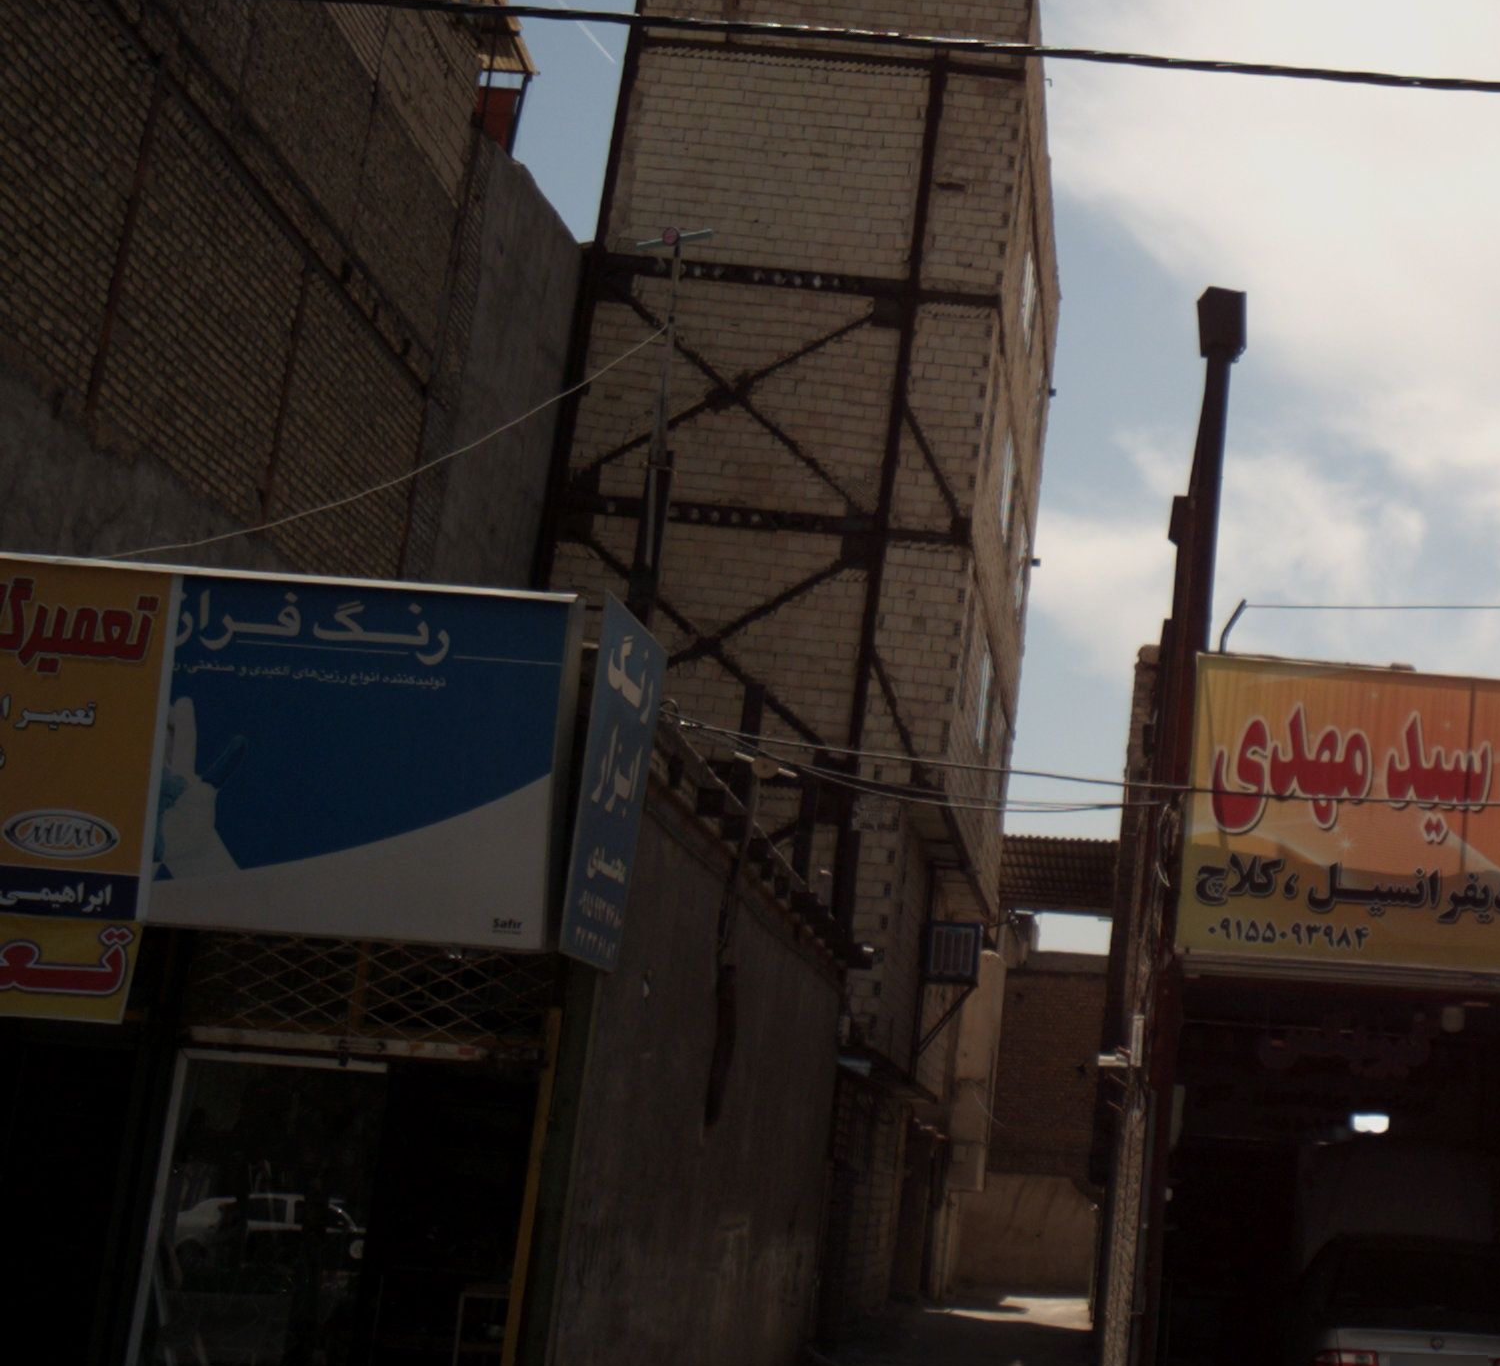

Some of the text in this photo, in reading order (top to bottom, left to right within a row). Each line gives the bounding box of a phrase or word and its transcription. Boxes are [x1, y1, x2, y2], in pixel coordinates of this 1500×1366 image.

[0, 576, 160, 675] تعمیرگ
[313, 600, 450, 665] رنگ
[238, 665, 248, 677] و
[348, 671, 380, 686] انواع
[607, 635, 653, 725] رنگ
[13, 699, 97, 731] تعمیر
[590, 723, 643, 818] ابزار
[1212, 703, 1372, 833] مهدی
[1385, 712, 1492, 842] سید
[0, 881, 112, 913] ابراهیمی
[1195, 853, 1285, 905] کلاچ
[0, 926, 133, 996] تع
